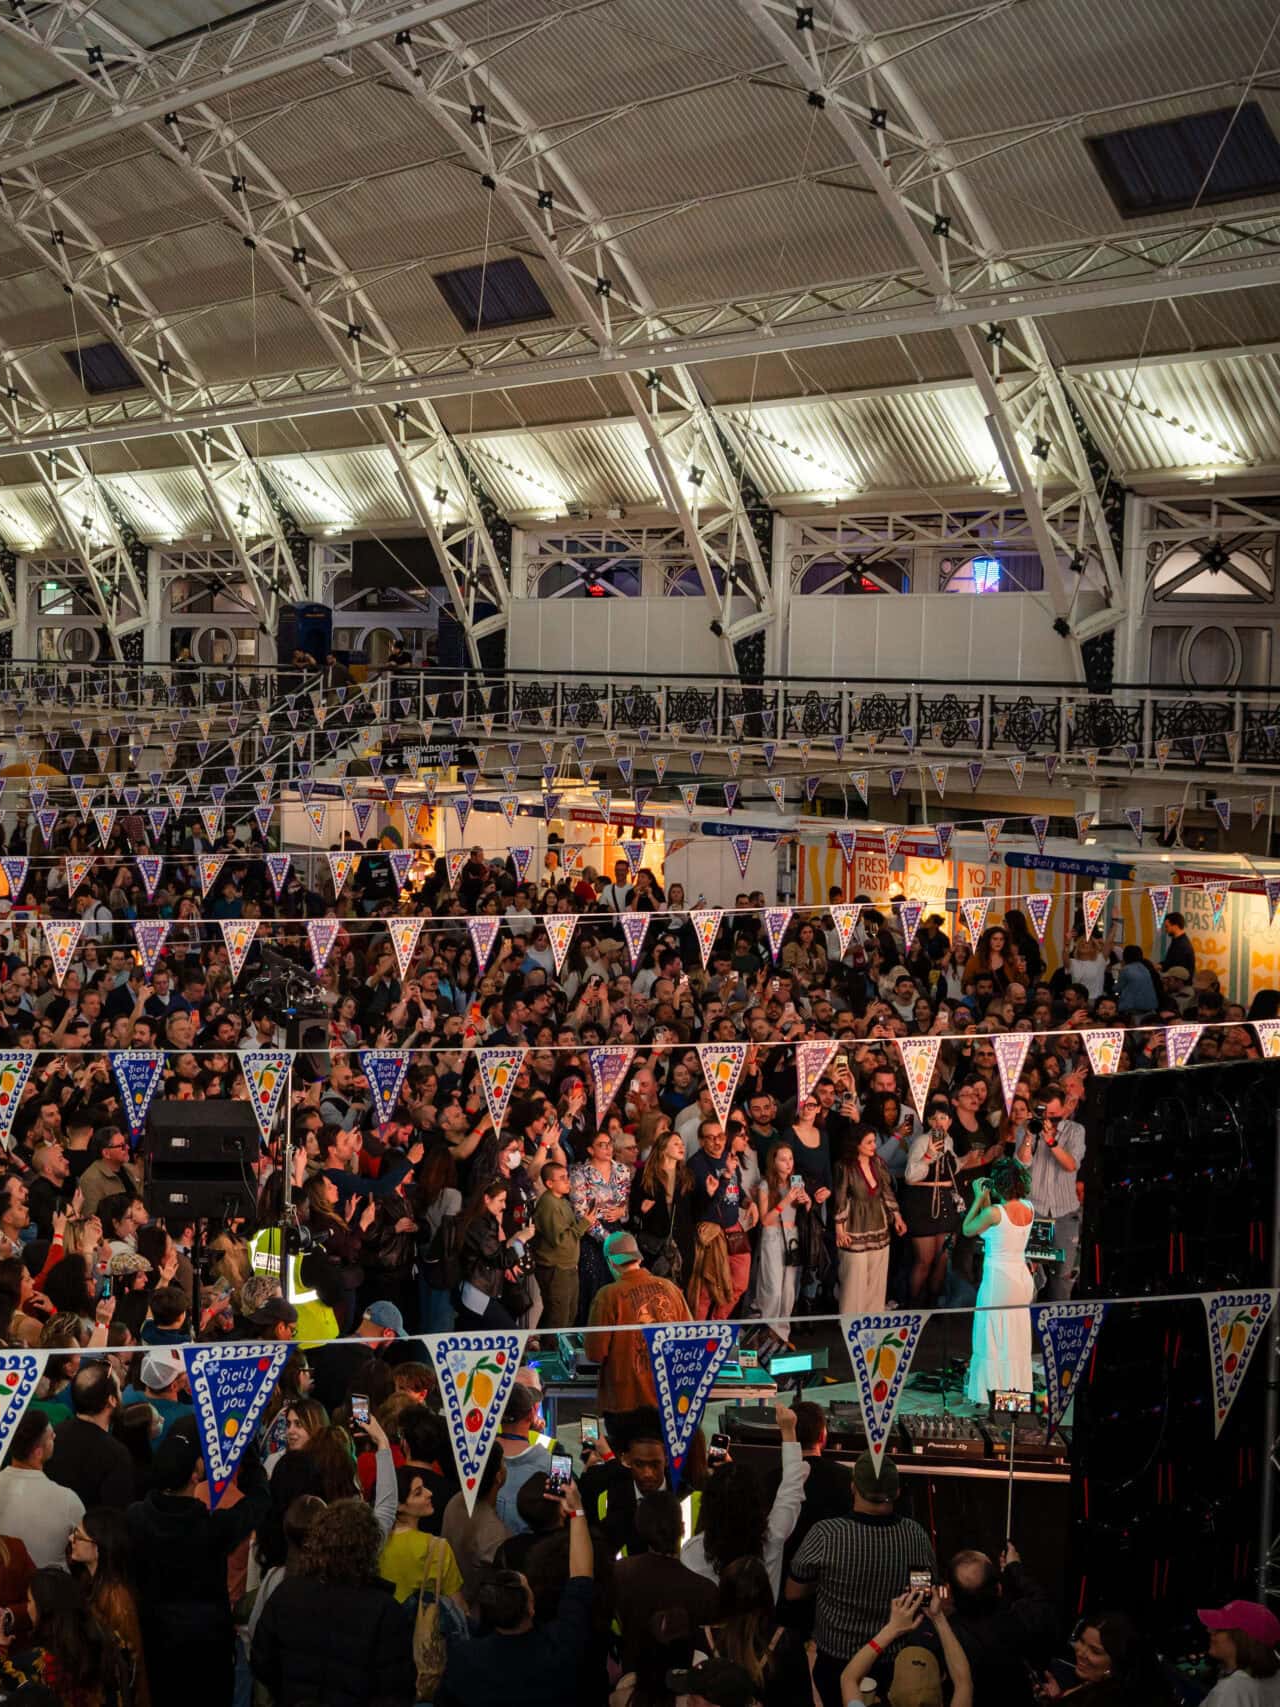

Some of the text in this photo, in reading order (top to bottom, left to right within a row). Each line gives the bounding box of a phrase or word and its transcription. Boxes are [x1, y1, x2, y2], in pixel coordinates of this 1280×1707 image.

[1184, 911, 1226, 934] PASA
[1056, 1326, 1083, 1340] Sicily
[1057, 1338, 1082, 1352] loves
[671, 1348, 705, 1363] Sicily
[1060, 1351, 1076, 1364] you
[217, 1366, 256, 1385] Sicily
[671, 1362, 702, 1375] loves
[217, 1381, 253, 1397] loves
[675, 1375, 695, 1391] you
[221, 1398, 246, 1413] you
